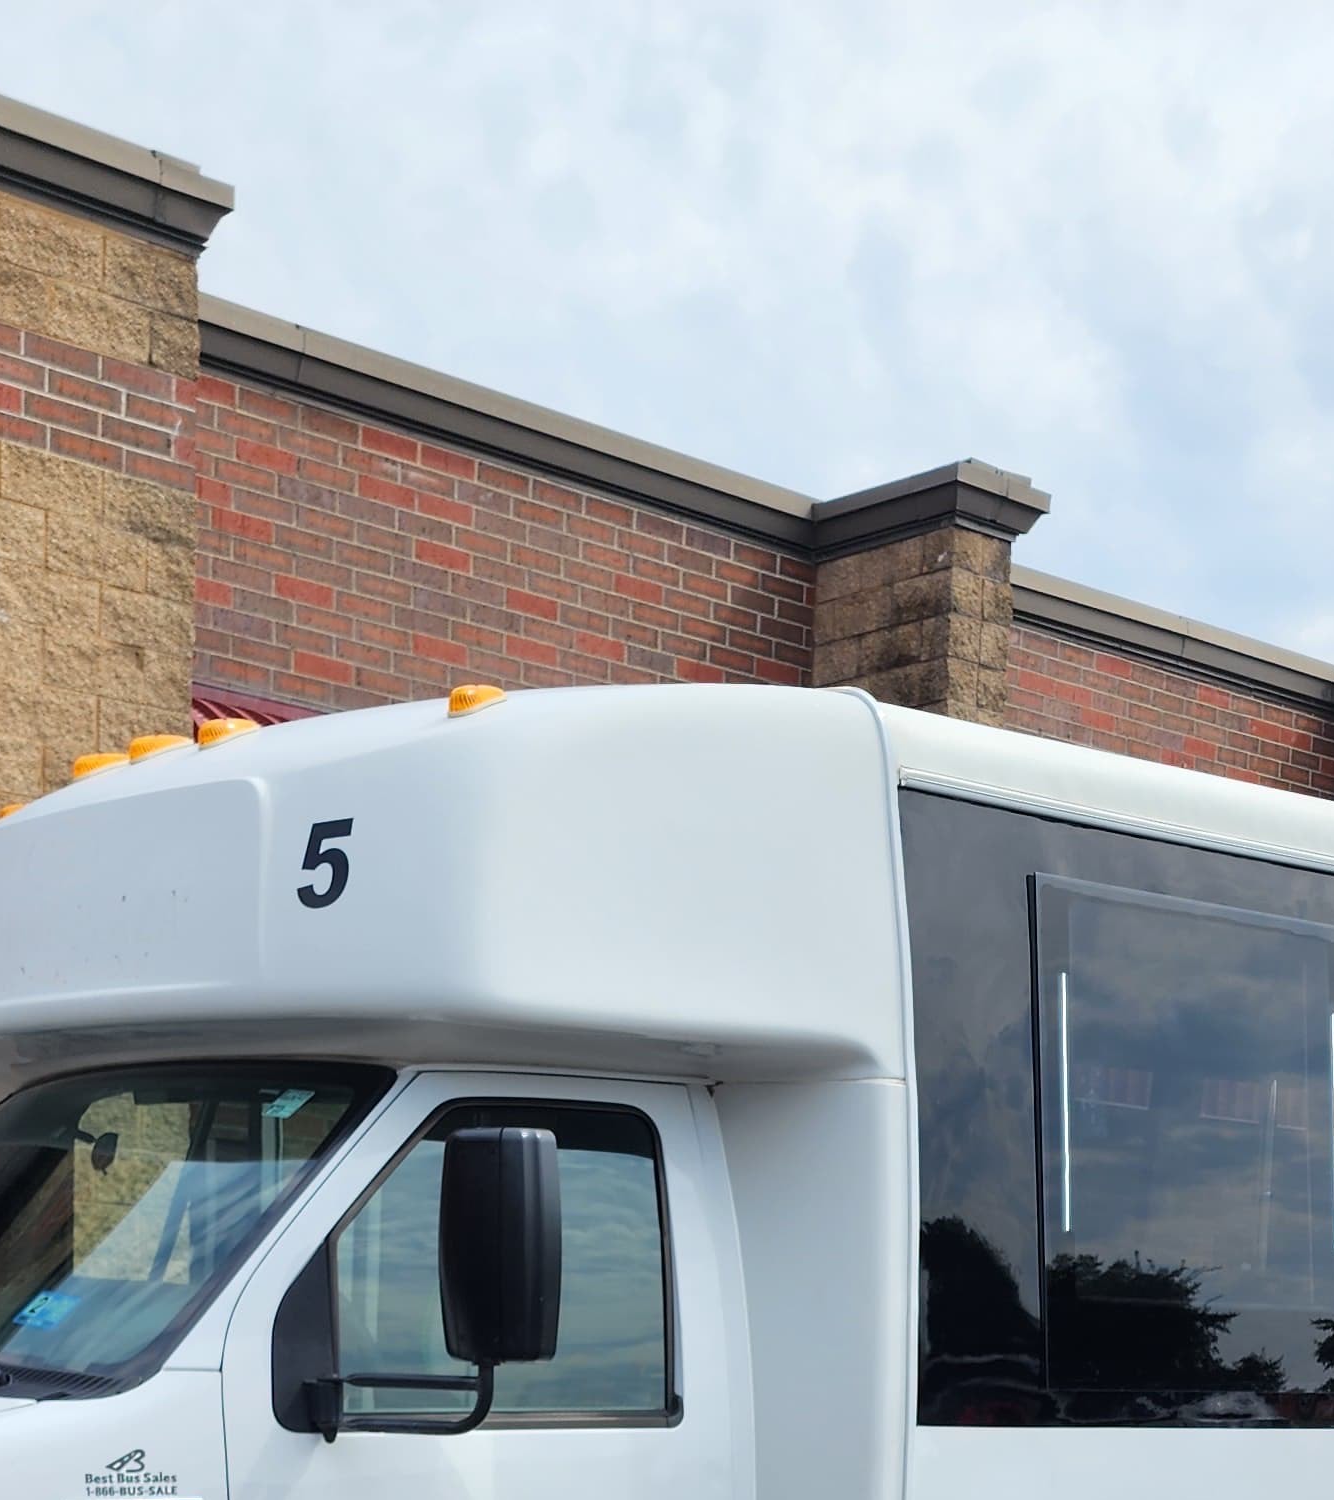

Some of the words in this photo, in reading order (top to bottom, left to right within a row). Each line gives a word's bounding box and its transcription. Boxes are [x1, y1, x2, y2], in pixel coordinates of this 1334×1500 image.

[296, 817, 354, 909] 5
[84, 1473, 113, 1484] Best
[117, 1473, 140, 1483] Bus
[143, 1471, 178, 1483] Sales
[86, 1485, 178, 1497] 1-866-BUS-SALE
